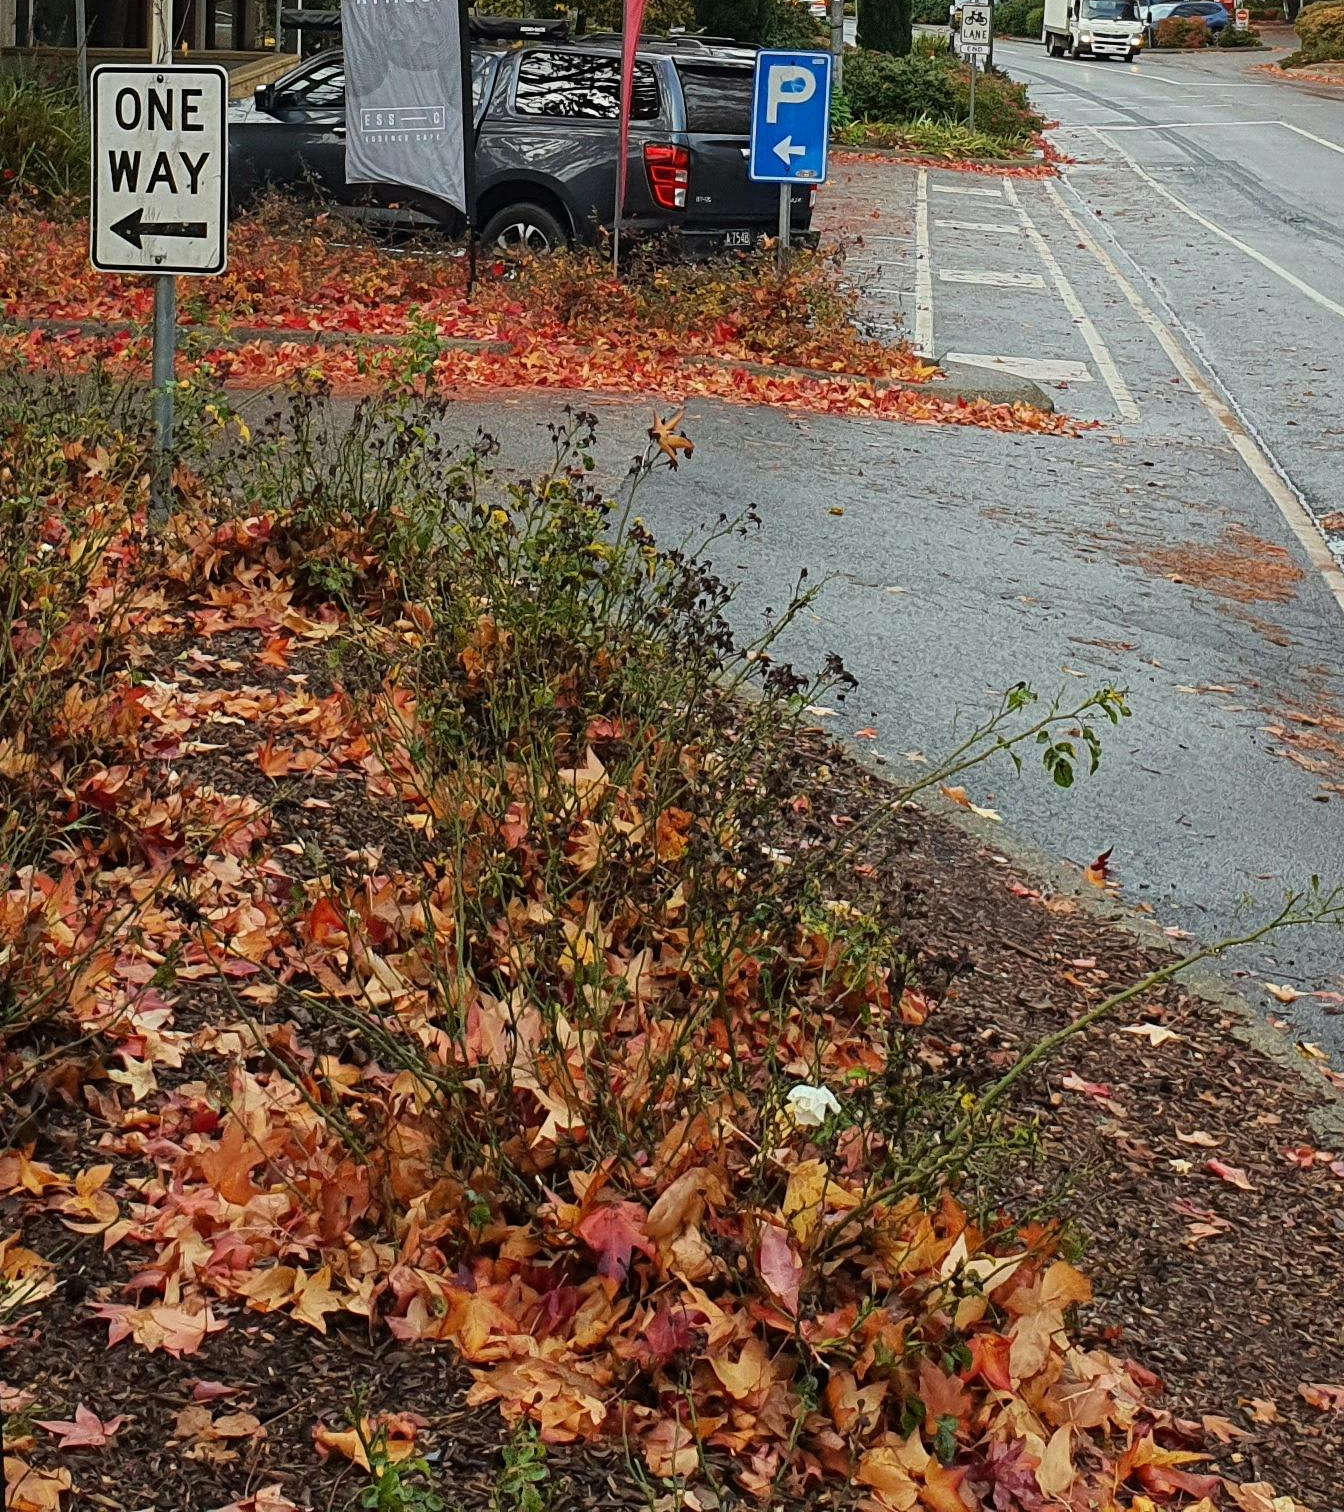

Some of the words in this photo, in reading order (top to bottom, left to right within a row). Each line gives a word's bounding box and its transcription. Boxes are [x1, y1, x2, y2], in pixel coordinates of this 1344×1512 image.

[963, 29, 987, 39] LANE
[115, 87, 204, 131] ONE
[766, 65, 816, 124] P
[108, 150, 211, 195] WAY
